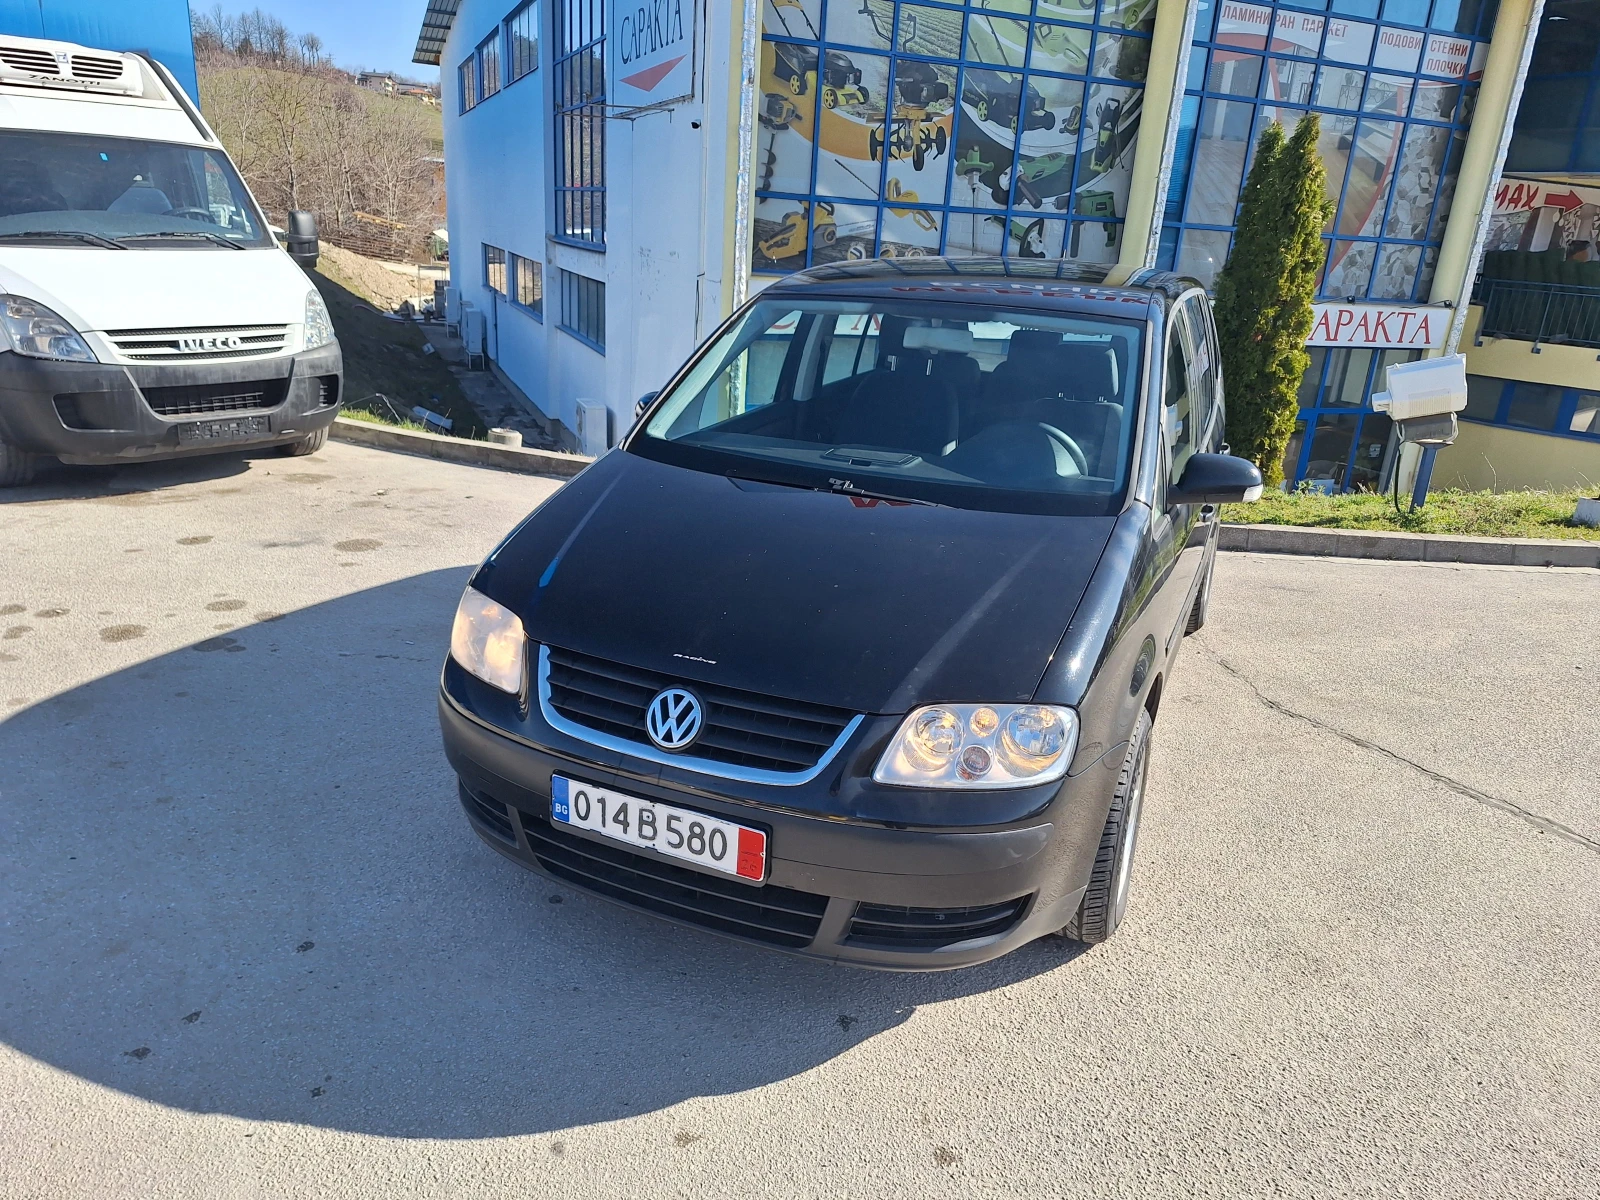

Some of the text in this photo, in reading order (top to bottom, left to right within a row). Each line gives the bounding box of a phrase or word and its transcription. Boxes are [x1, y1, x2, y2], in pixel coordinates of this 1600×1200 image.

[1222, 5, 1348, 37] ЛАМИНИРАН ПАРКЕТ
[1380, 32, 1469, 57] ПОДОВИ СТЕННИ
[1426, 58, 1467, 75] ПЛОЧКИ
[29, 74, 101, 85] ZANOTTI
[1308, 309, 1431, 344] АРАКТА
[178, 336, 241, 352] IVECO
[555, 802, 568, 815] BG
